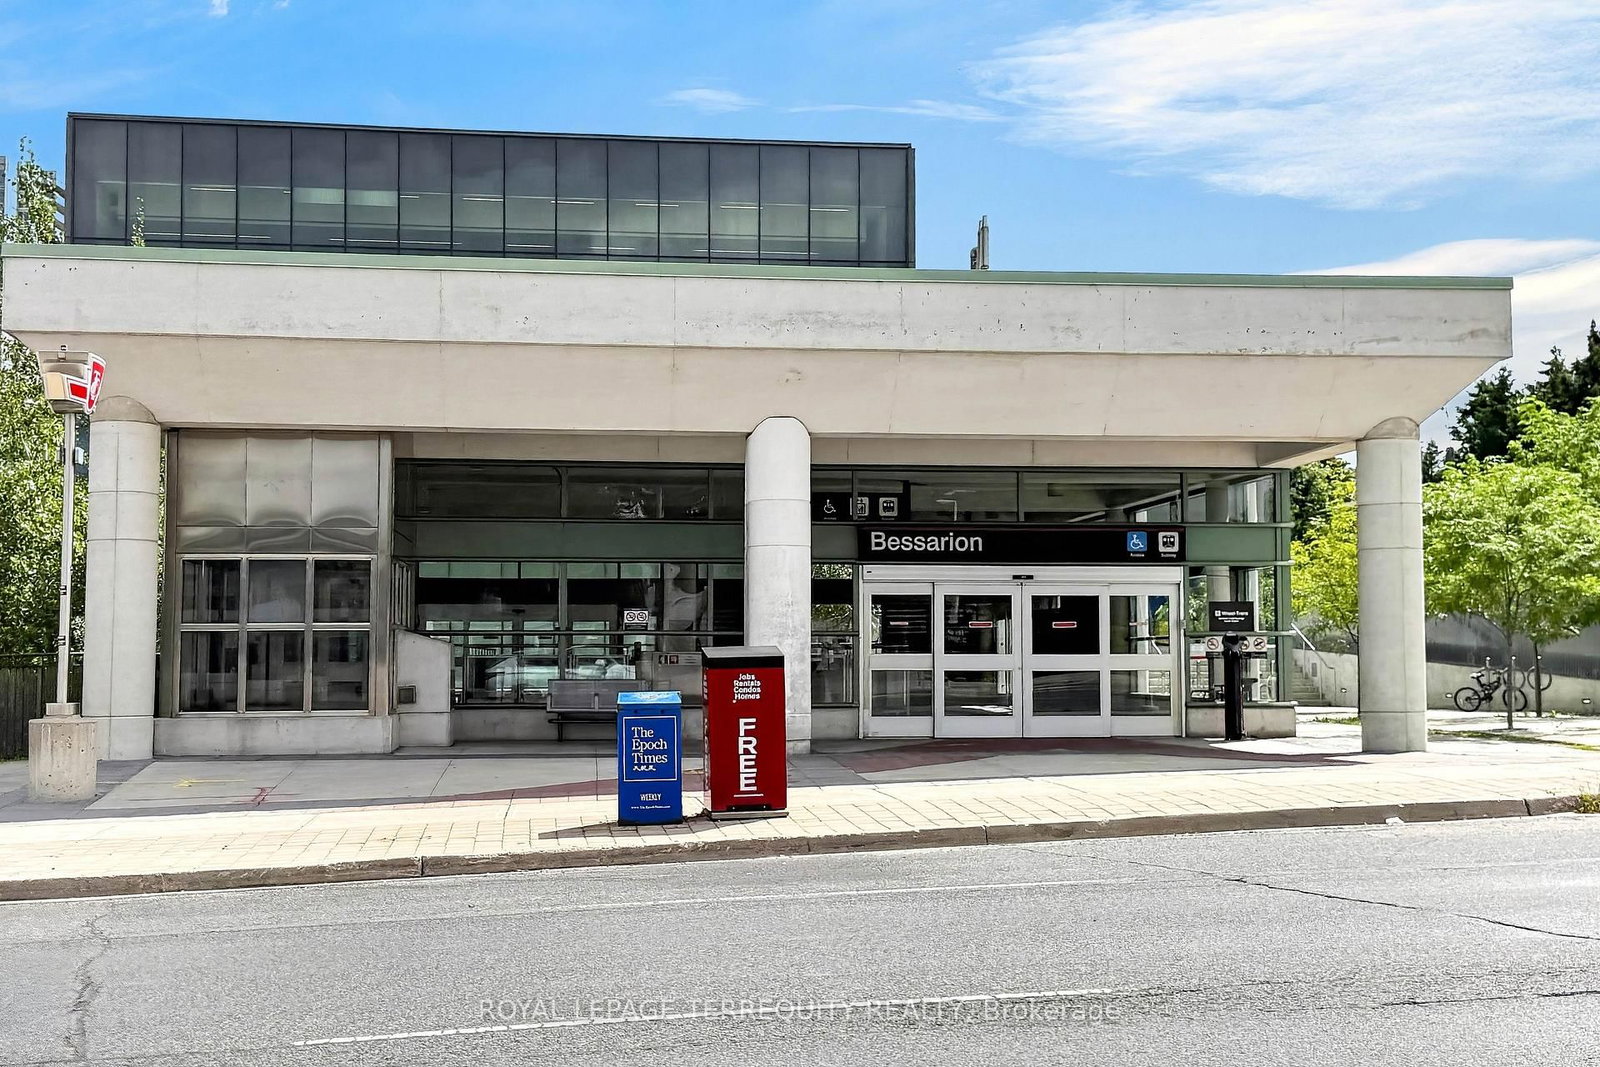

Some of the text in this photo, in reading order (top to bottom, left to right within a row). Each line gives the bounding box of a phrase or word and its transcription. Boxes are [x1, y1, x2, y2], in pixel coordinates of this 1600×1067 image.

[870, 531, 983, 551] Bessarion
[631, 726, 654, 738] The
[631, 738, 668, 753] Epoch
[631, 752, 668, 764] Times
[738, 717, 758, 791] FREE
[640, 793, 661, 801] WEEKLY
